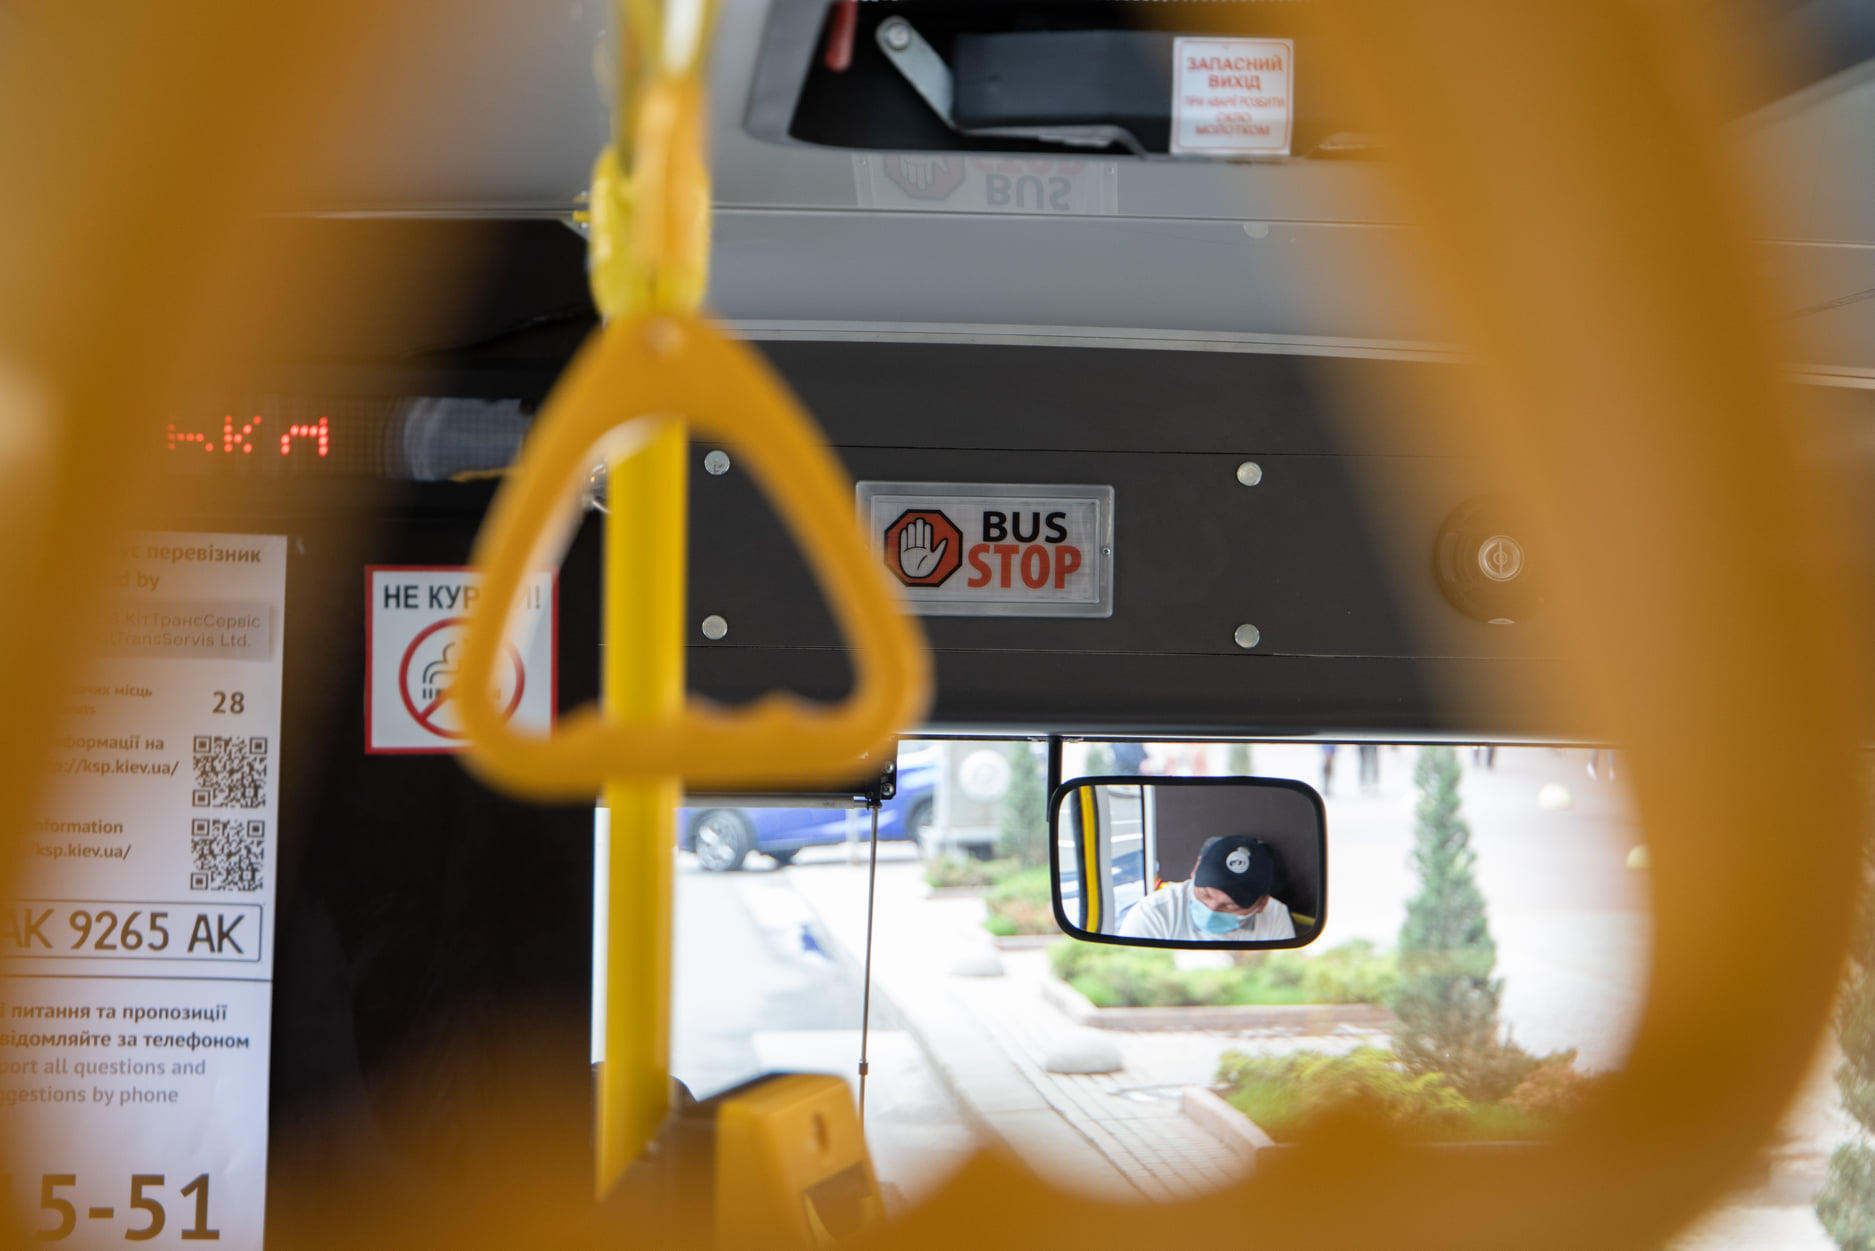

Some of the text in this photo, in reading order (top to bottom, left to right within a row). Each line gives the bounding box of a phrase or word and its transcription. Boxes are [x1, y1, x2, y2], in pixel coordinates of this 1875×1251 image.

[1187, 55, 1283, 72] ЗАПАСНИЙ
[1208, 75, 1261, 91] ВИХІД
[982, 511, 1067, 543] BUS
[147, 544, 261, 564] перевізник
[967, 544, 1082, 589] STOP
[137, 570, 160, 592] by
[384, 585, 420, 609] НЕ
[212, 691, 245, 715] 28
[145, 739, 164, 751] на
[69, 909, 169, 951] 9265
[11, 1005, 91, 1019] питання
[97, 1006, 116, 1019] та
[122, 1004, 228, 1023] пропозиції
[117, 1036, 137, 1047] за
[143, 1032, 249, 1051] телефоном
[44, 1058, 68, 1075] all
[74, 1058, 165, 1078] questions
[171, 1059, 206, 1075] and
[93, 1086, 114, 1106] by
[120, 1086, 179, 1107] phone
